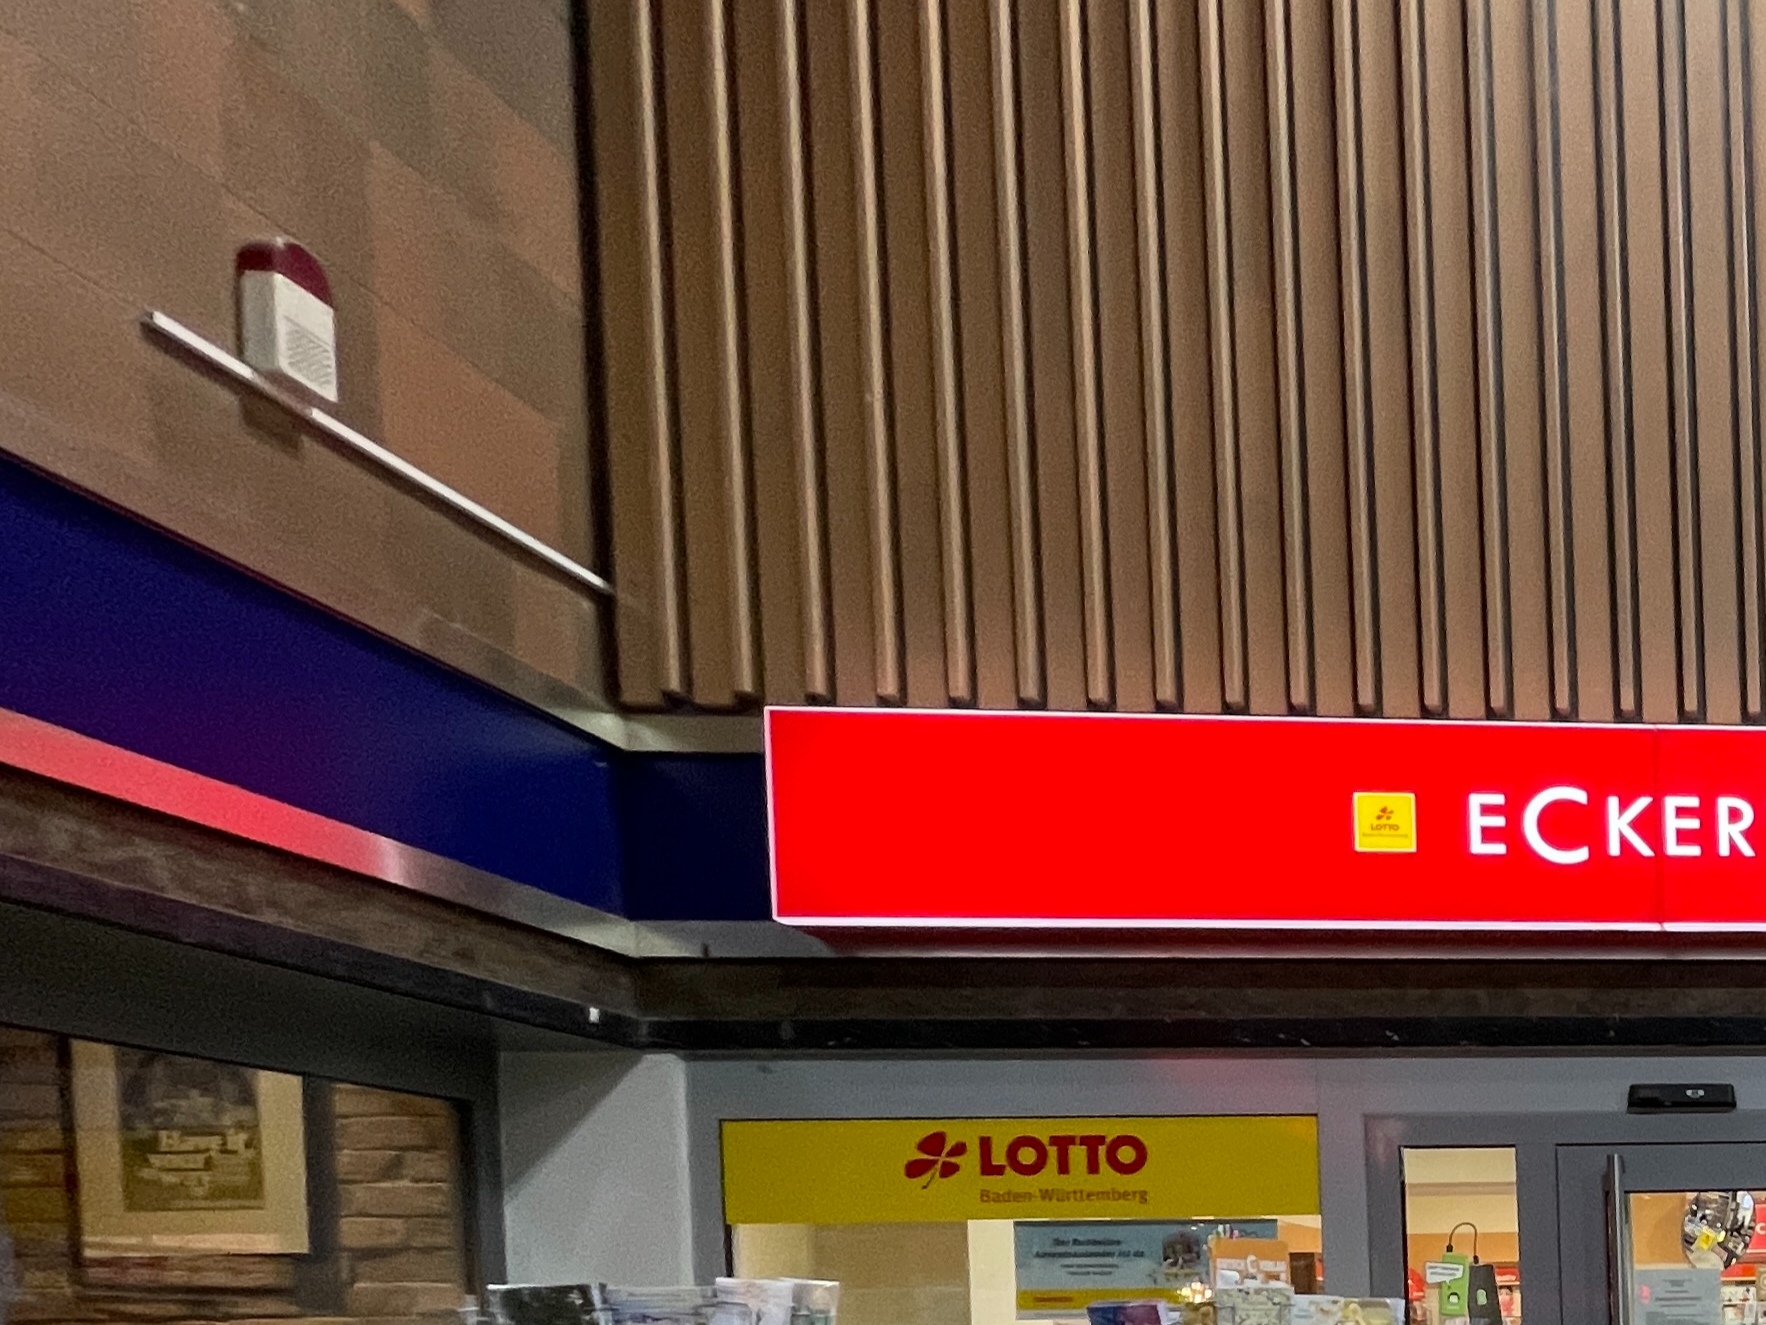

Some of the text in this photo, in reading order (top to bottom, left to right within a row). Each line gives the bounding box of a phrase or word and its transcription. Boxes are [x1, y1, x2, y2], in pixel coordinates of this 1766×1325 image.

[1370, 823, 1400, 831] LOTTO
[979, 1134, 1149, 1177] LOTTO
[979, 1187, 1149, 1205] Baden-Württemberg
